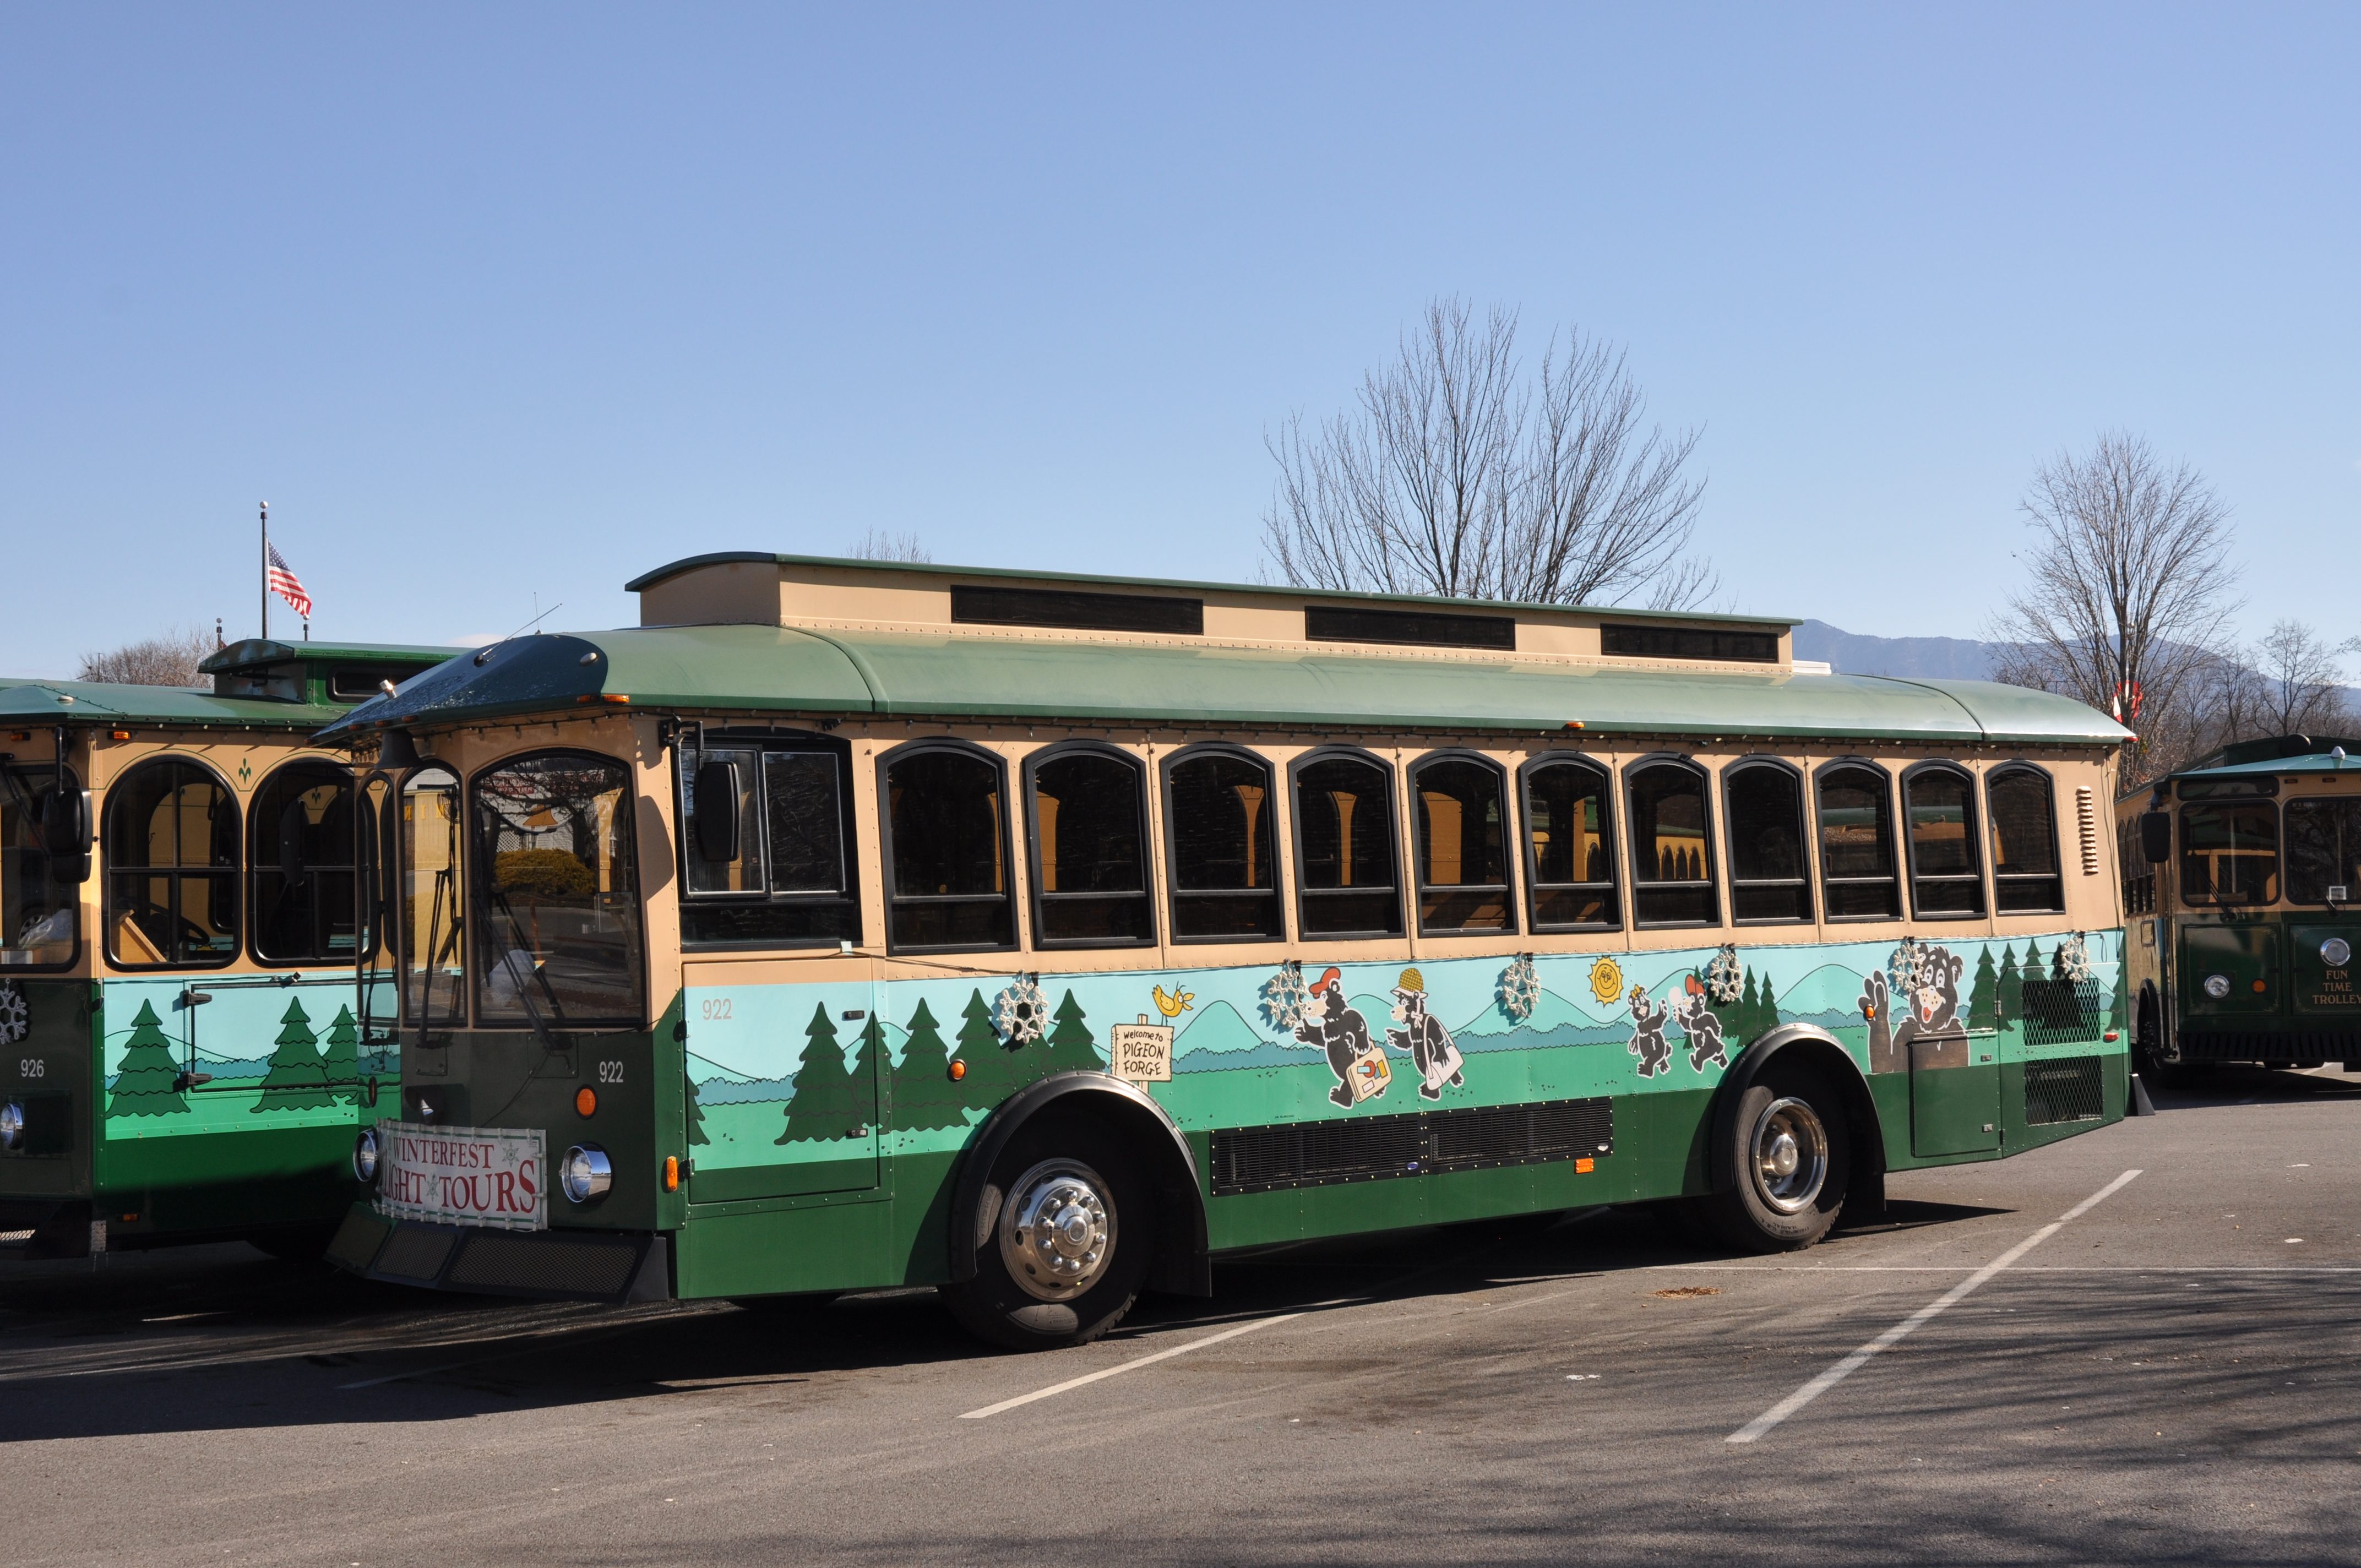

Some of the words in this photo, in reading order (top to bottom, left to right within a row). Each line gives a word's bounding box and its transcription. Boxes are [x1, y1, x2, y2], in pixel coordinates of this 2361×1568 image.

[2326, 970, 2348, 979] FUN
[2322, 982, 2353, 992] TIME
[2312, 995, 2361, 1004] TROLLEY
[703, 998, 732, 1020] 922
[1123, 1030, 1155, 1040] welcome
[1155, 1032, 1163, 1042] to
[1123, 1042, 1165, 1059] PIGEON
[21, 1059, 44, 1077] 926
[600, 1061, 623, 1082] 922
[1123, 1060, 1162, 1076] FORGE
[393, 1137, 494, 1168] WINTERFEST
[439, 1159, 536, 1213] TOURS
